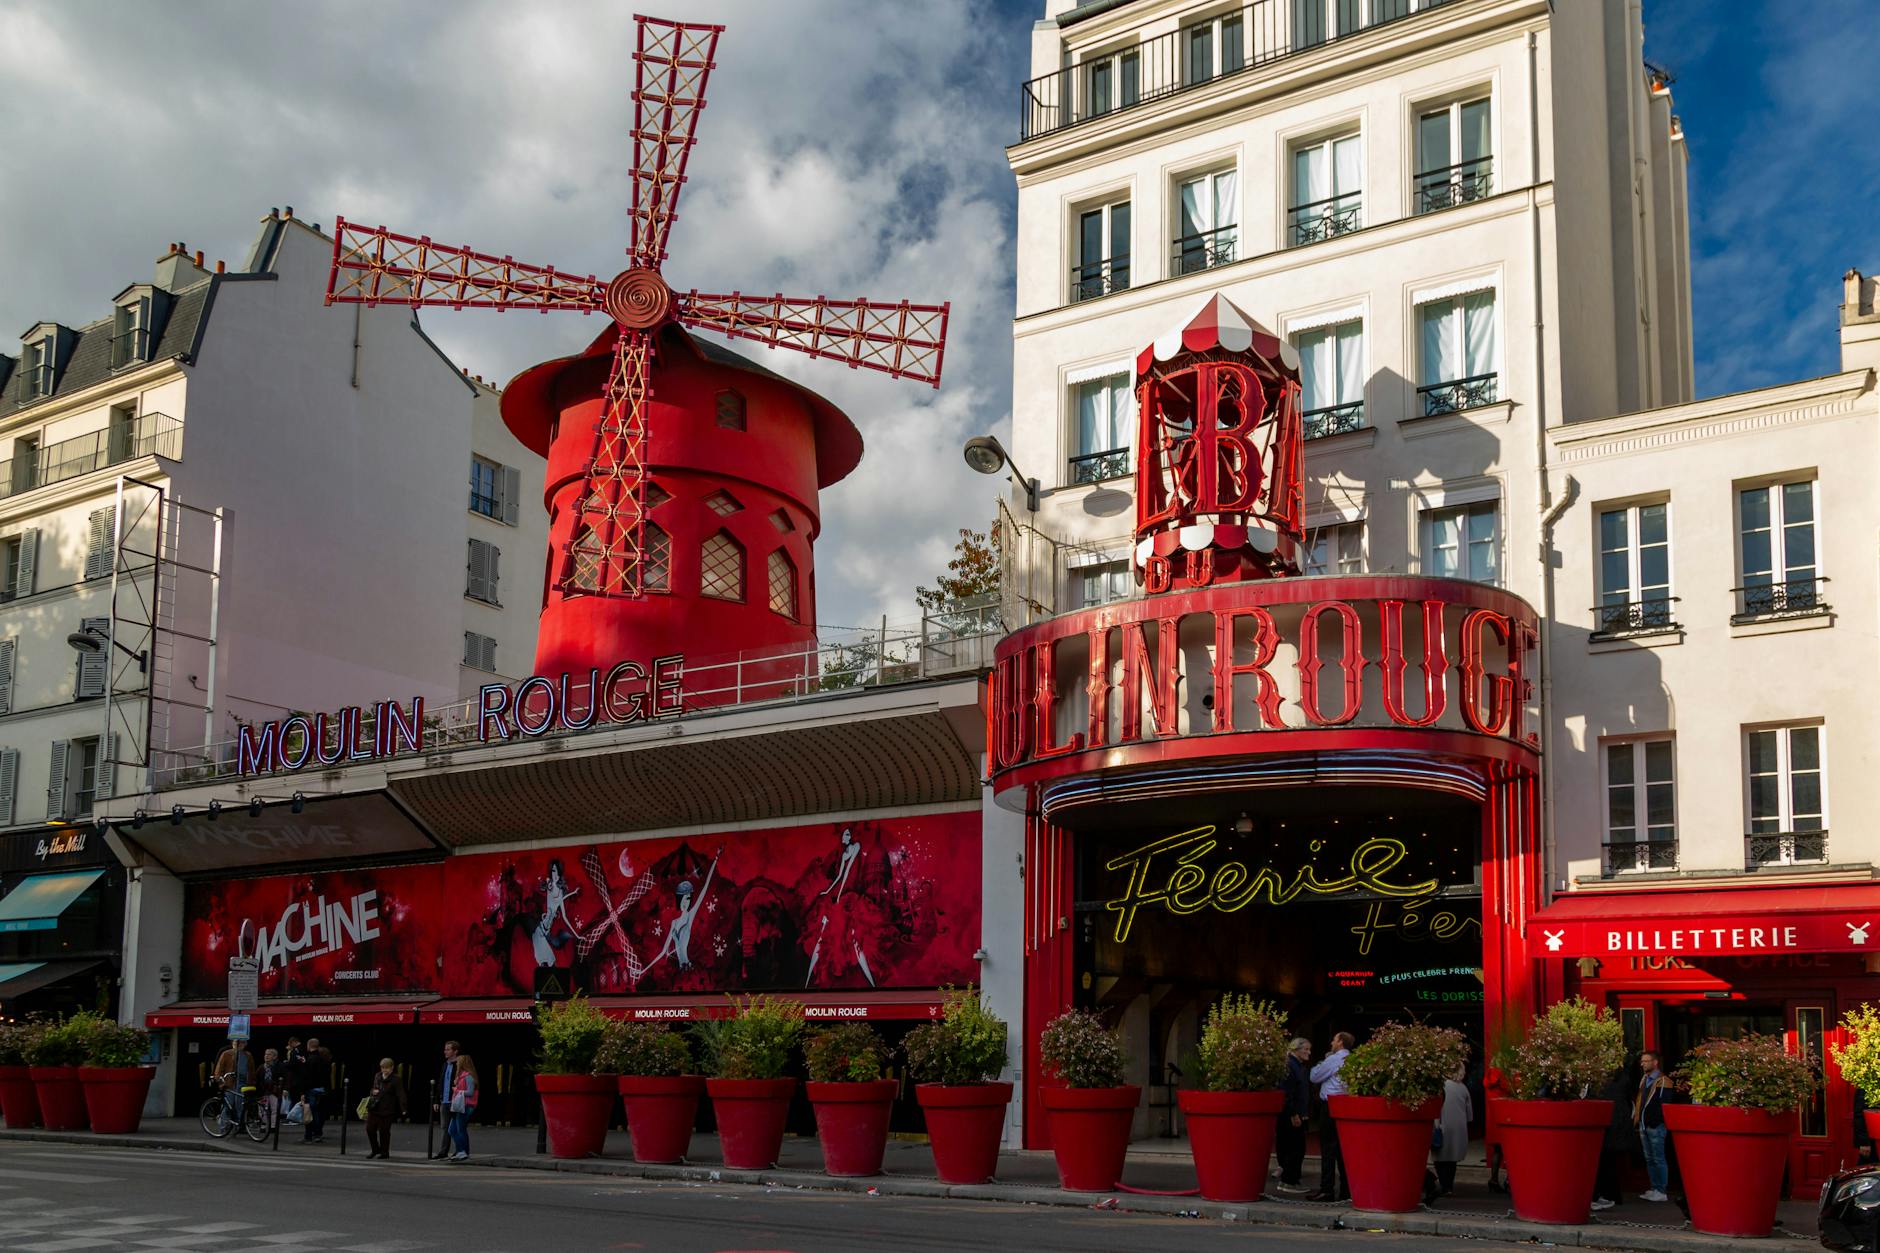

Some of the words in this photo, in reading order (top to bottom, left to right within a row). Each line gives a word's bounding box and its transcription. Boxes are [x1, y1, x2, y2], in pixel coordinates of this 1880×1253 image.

[1145, 550, 1215, 594] DU
[237, 696, 425, 776] MOULIN
[478, 653, 686, 744] ROUGE
[49, 836, 66, 854] the
[64, 833, 87, 853] Mill
[238, 889, 381, 973] MACHINE
[1607, 926, 1797, 951] BILLETTERIE
[334, 970, 363, 980] CONCERTS
[363, 970, 380, 979] CLUB
[1379, 975, 1390, 985] LE
[1391, 971, 1412, 983] PLUS
[1416, 989, 1438, 1000] LES
[485, 1011, 511, 1020] MOULIN
[634, 1009, 663, 1018] MOULIN
[663, 1009, 690, 1018] ROUGE
[805, 1007, 837, 1017] MOULIN
[837, 1007, 868, 1017] ROUGE
[193, 1016, 212, 1024] MOULIN
[212, 1016, 230, 1024] ROUGE
[312, 1015, 334, 1023] MOULIN
[334, 1014, 354, 1022] ROUGE
